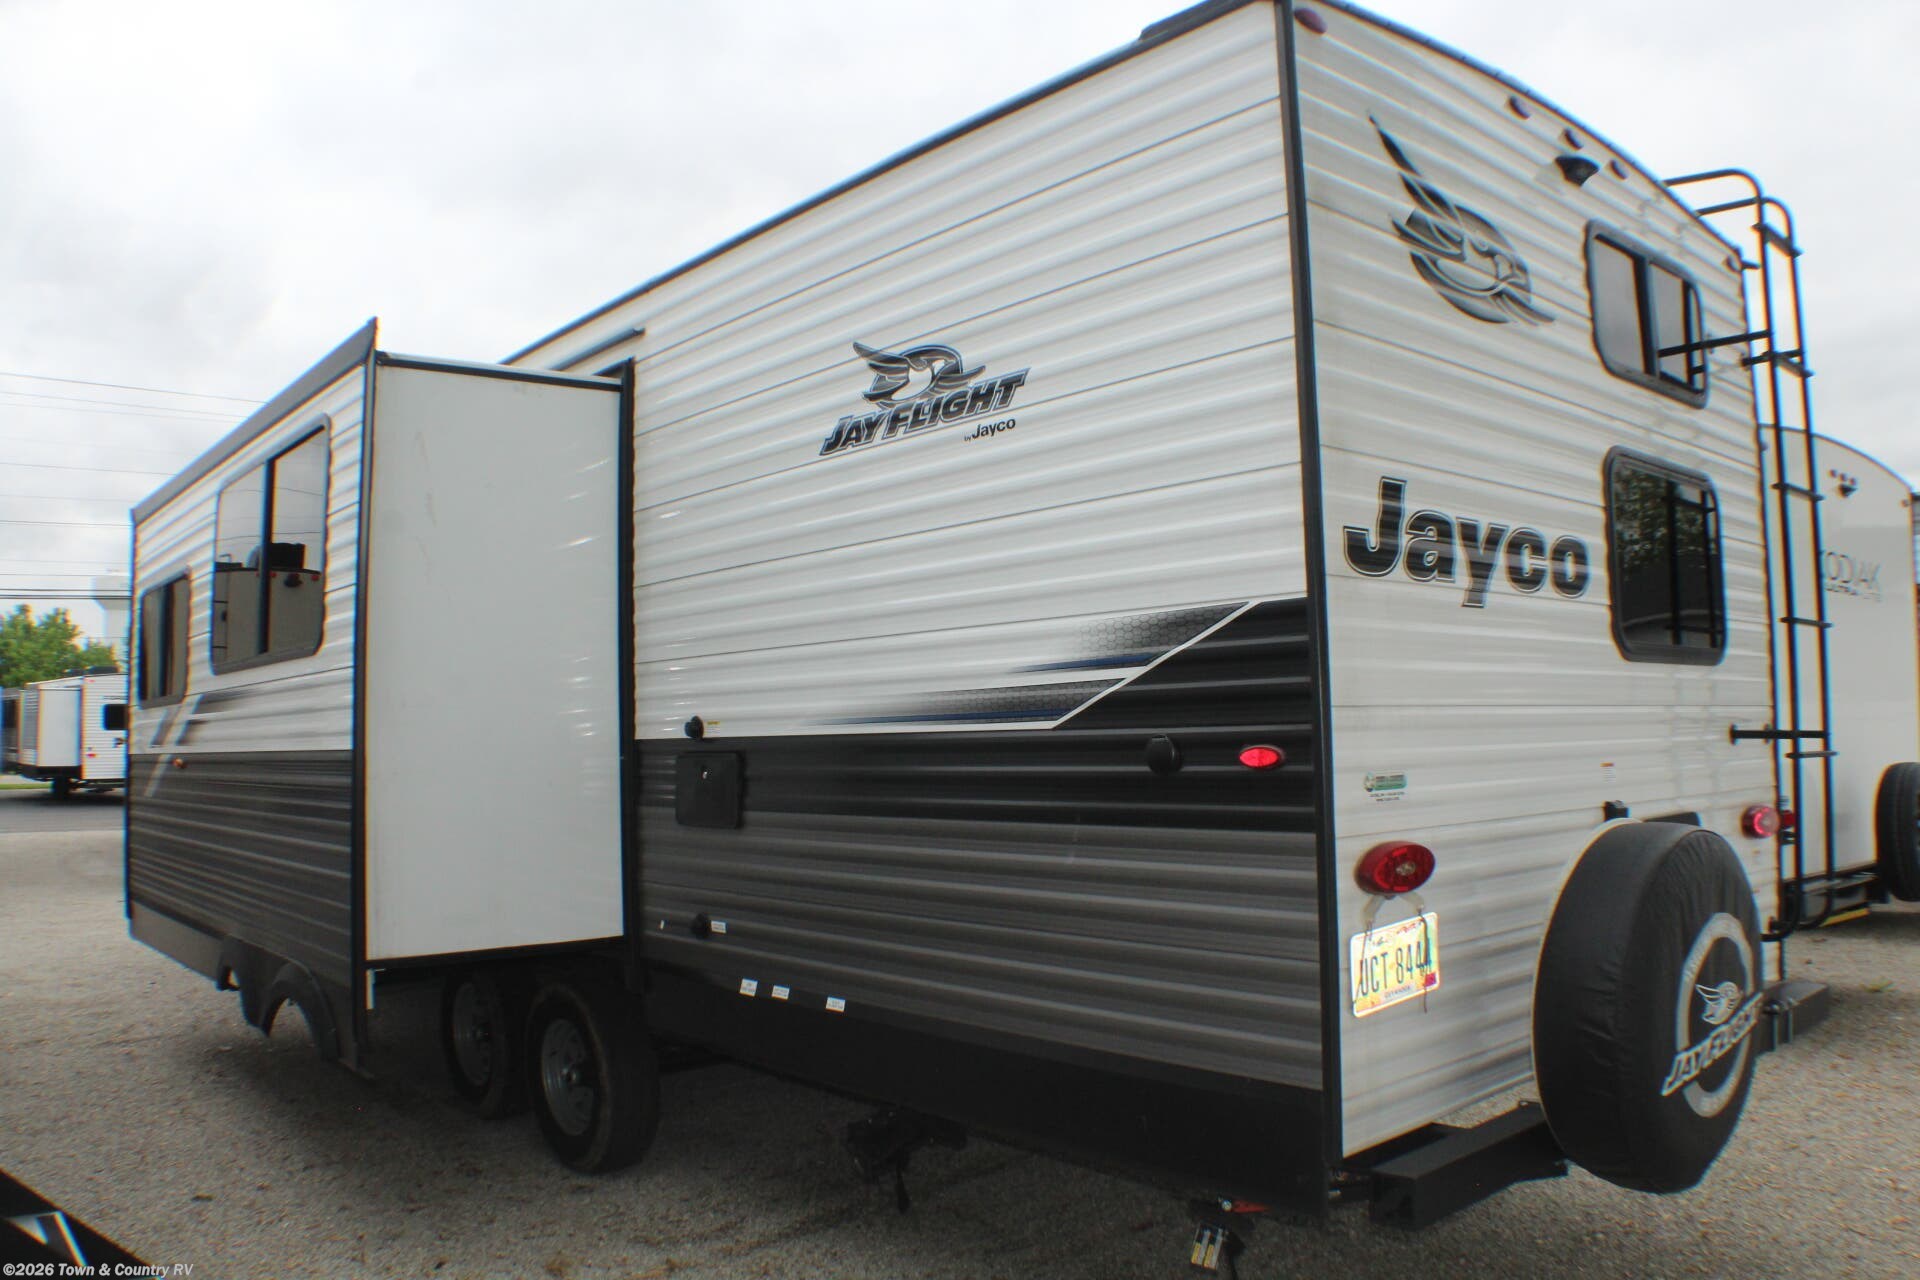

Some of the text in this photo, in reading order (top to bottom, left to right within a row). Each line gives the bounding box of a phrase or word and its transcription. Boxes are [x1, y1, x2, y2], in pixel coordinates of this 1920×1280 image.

[819, 367, 1032, 456] JAY FLIGHT
[972, 417, 1016, 440] Jayco
[1343, 476, 1592, 608] Jayco
[1821, 550, 1881, 591] ODIAK
